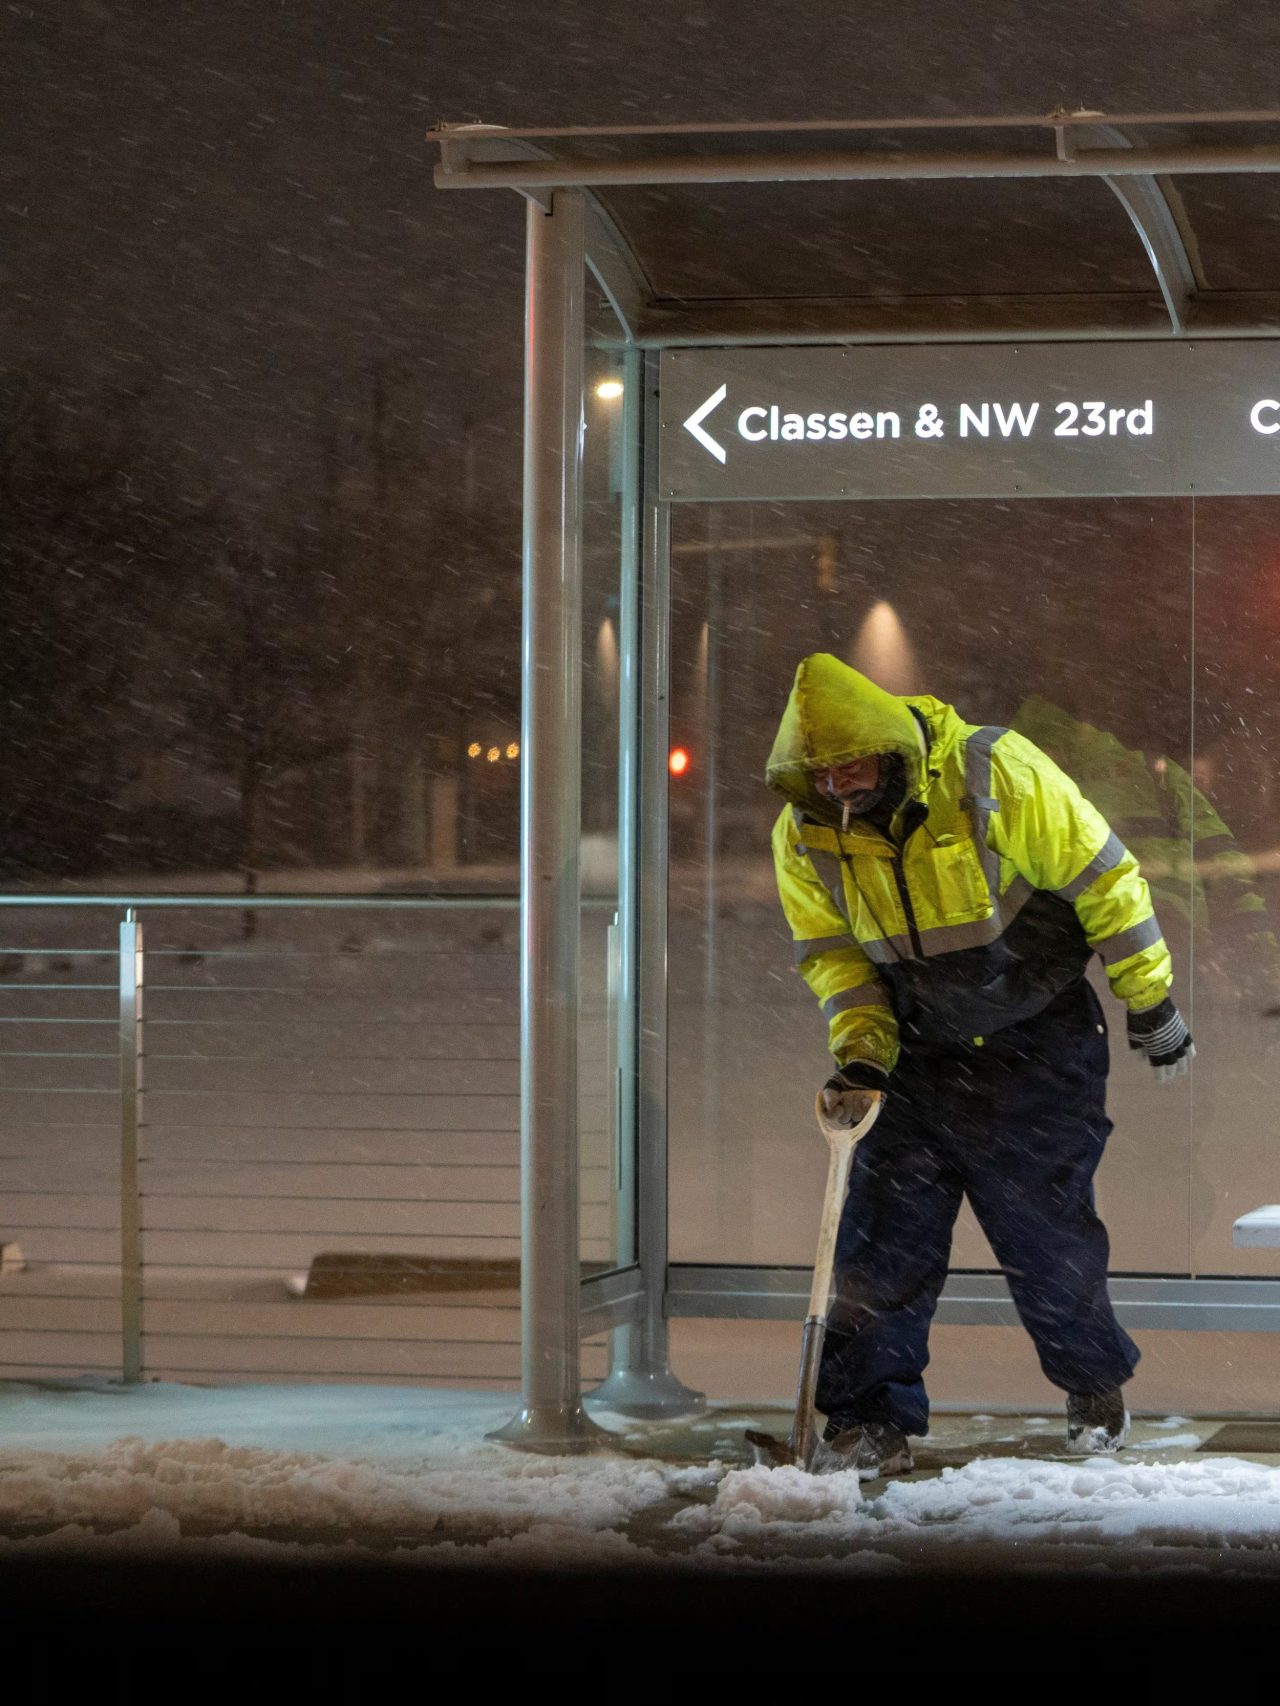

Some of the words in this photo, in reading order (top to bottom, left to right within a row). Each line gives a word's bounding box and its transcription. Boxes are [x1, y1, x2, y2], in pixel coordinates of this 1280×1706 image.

[737, 405, 901, 442] Classen
[914, 403, 945, 439] &
[959, 402, 1040, 438] NW
[1053, 399, 1153, 437] 23rd
